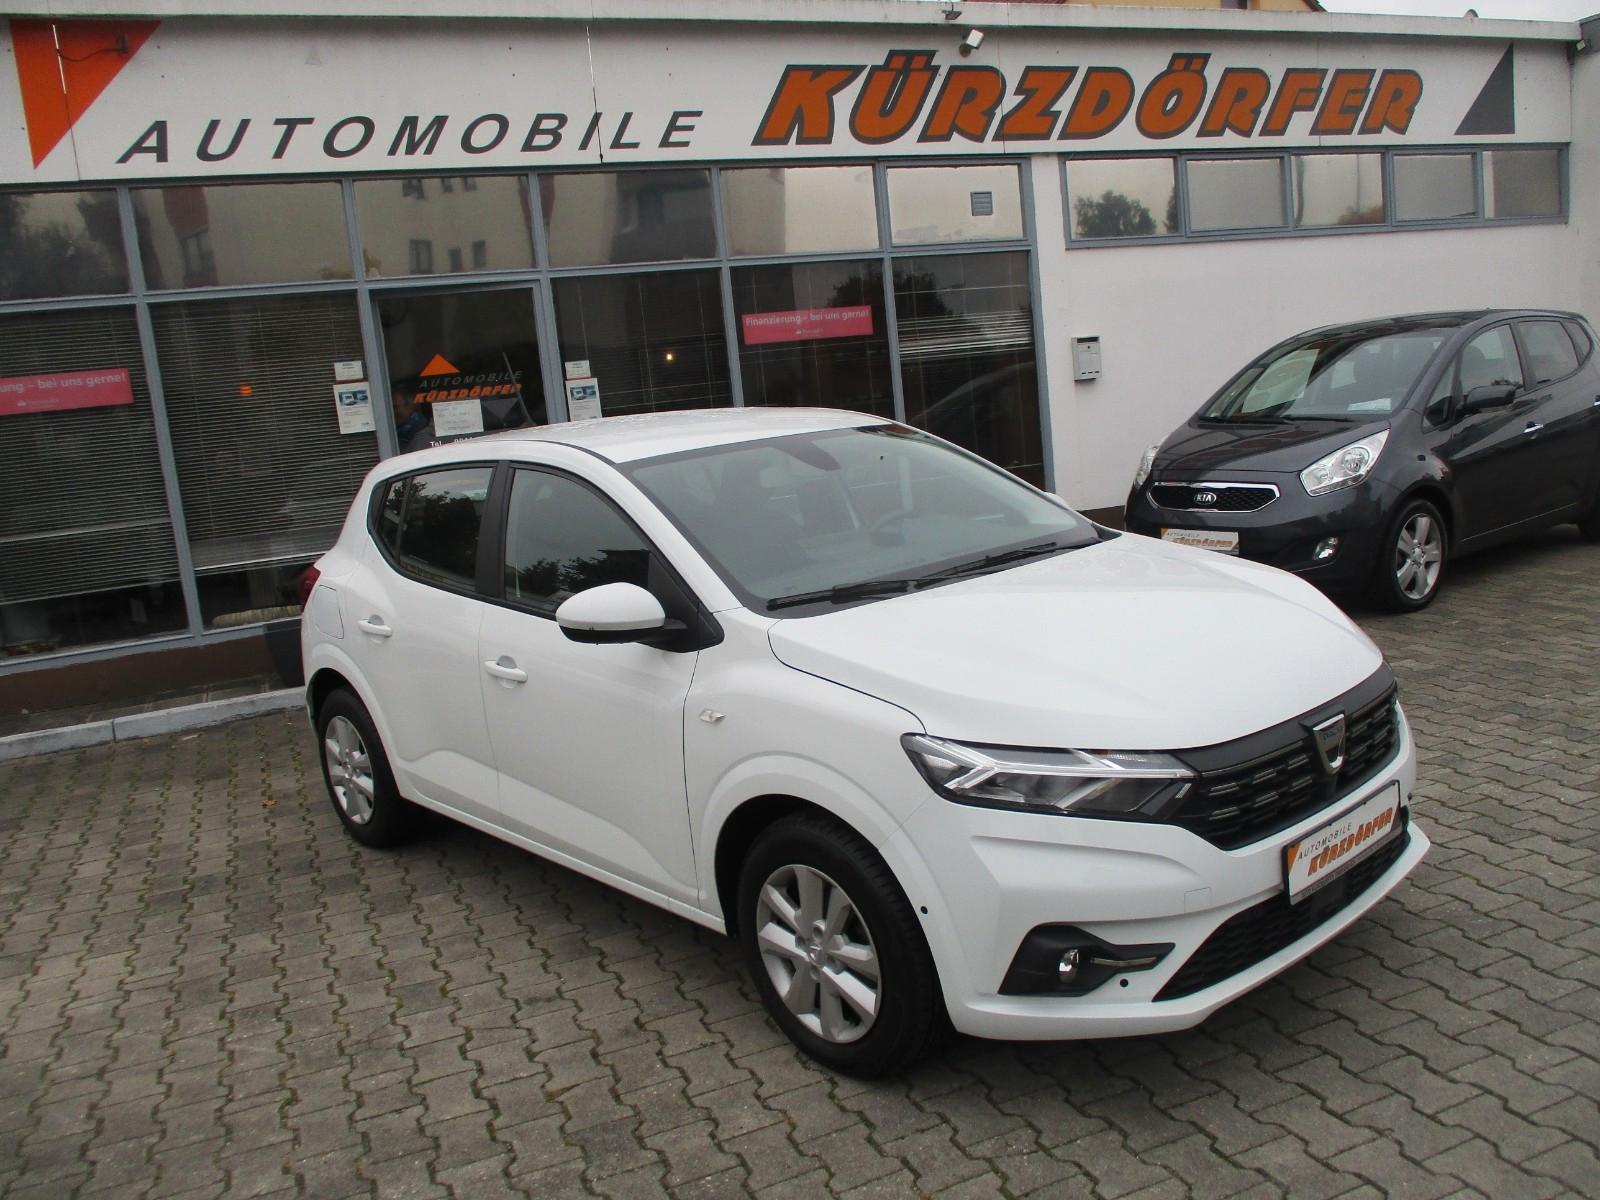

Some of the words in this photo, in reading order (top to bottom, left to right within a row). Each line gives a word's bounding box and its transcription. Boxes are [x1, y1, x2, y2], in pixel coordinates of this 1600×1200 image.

[751, 49, 1424, 147] KÜRZDÖRFER
[116, 110, 705, 165] AUTOMOBILE
[745, 315, 802, 327] Finanzierung
[809, 312, 823, 321] bei
[826, 311, 840, 320] uns
[37, 378, 57, 389] bei
[61, 378, 82, 387] uns
[86, 373, 125, 387] gerne!
[420, 370, 523, 388] AUTOMOBILE
[1196, 493, 1212, 502] KIA
[1298, 823, 1351, 860] AUTOMOBILE
